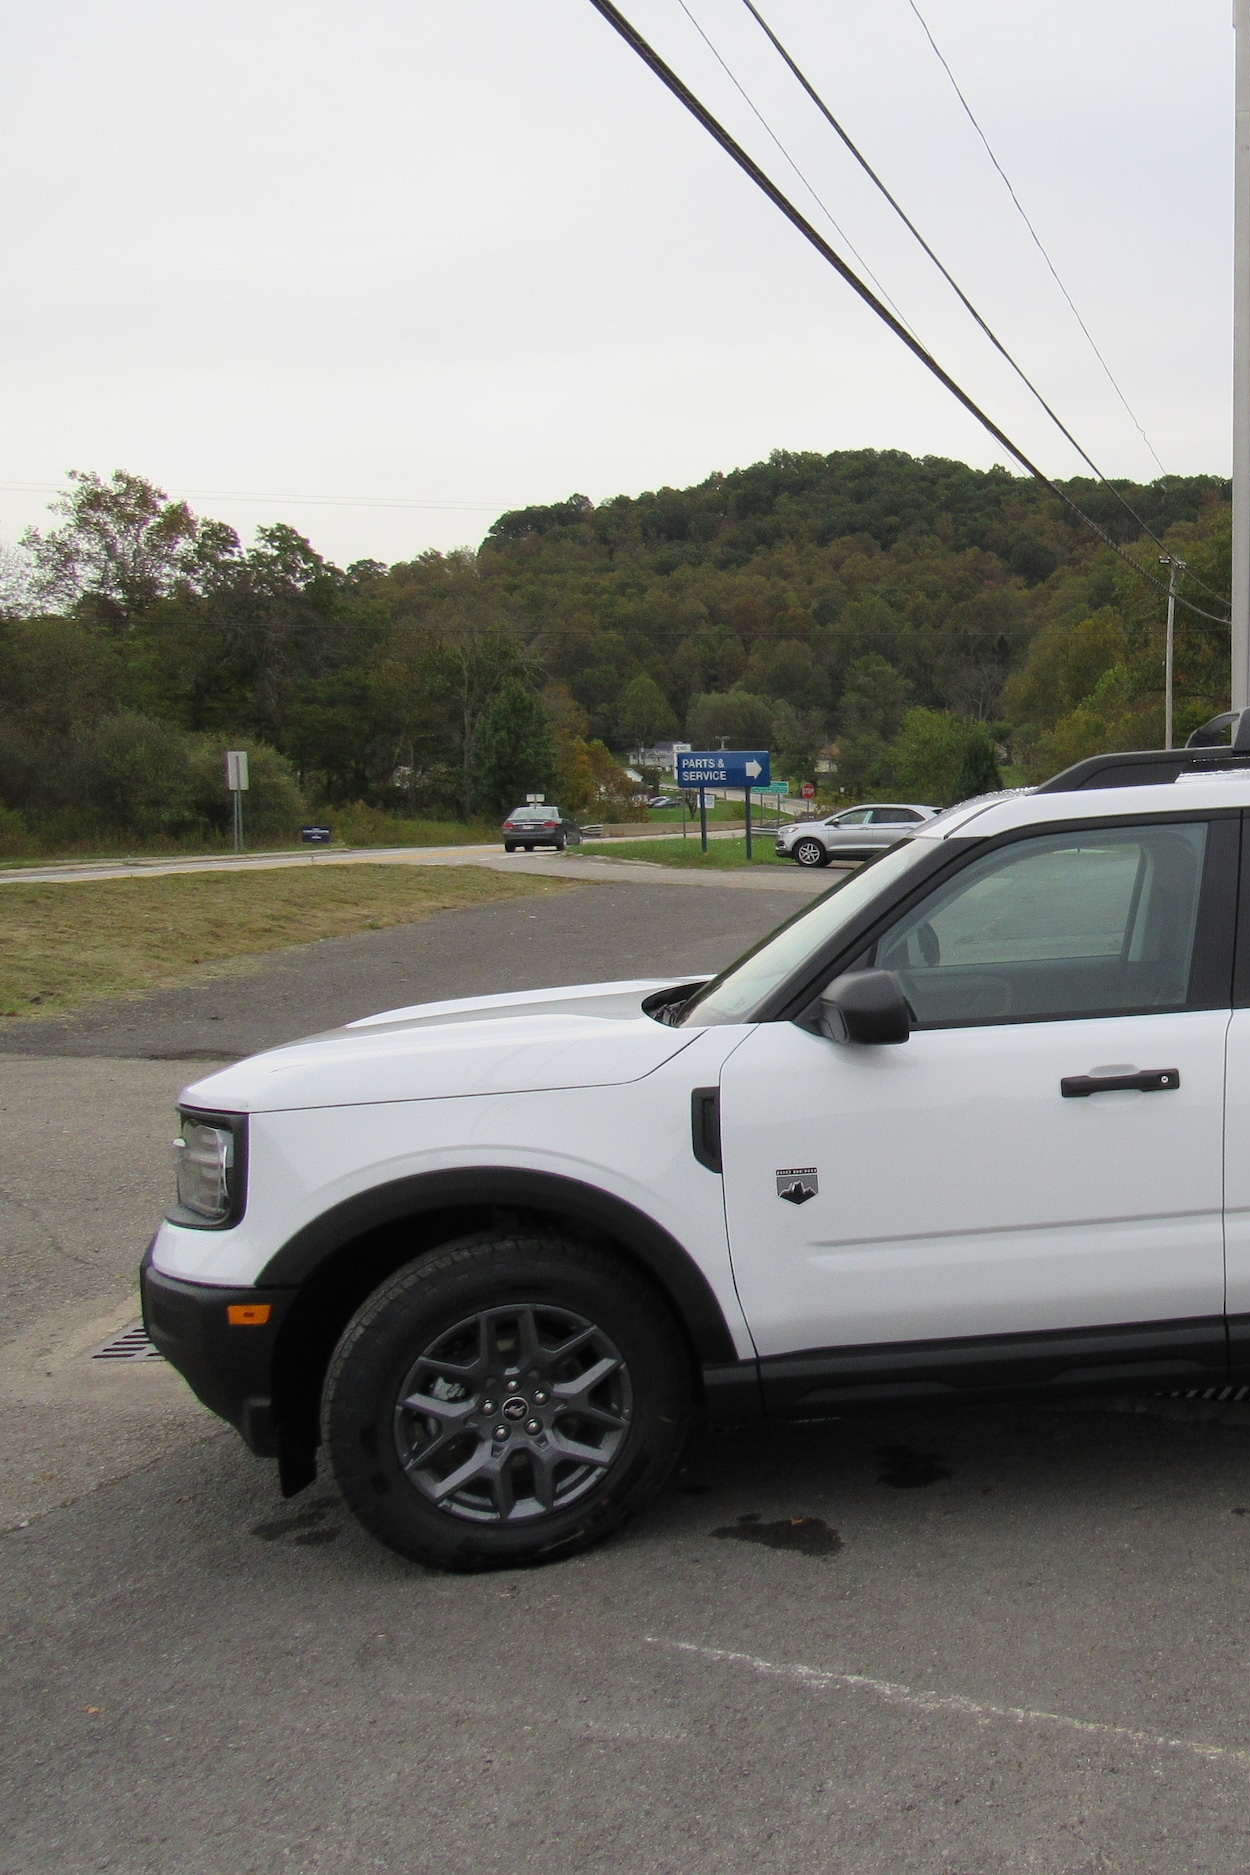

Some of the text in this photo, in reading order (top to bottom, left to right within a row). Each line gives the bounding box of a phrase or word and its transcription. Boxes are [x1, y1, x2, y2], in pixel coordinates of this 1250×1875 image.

[682, 758, 725, 769] PARTS &
[682, 770, 727, 781] SERVICE
[802, 787, 815, 795] STOP
